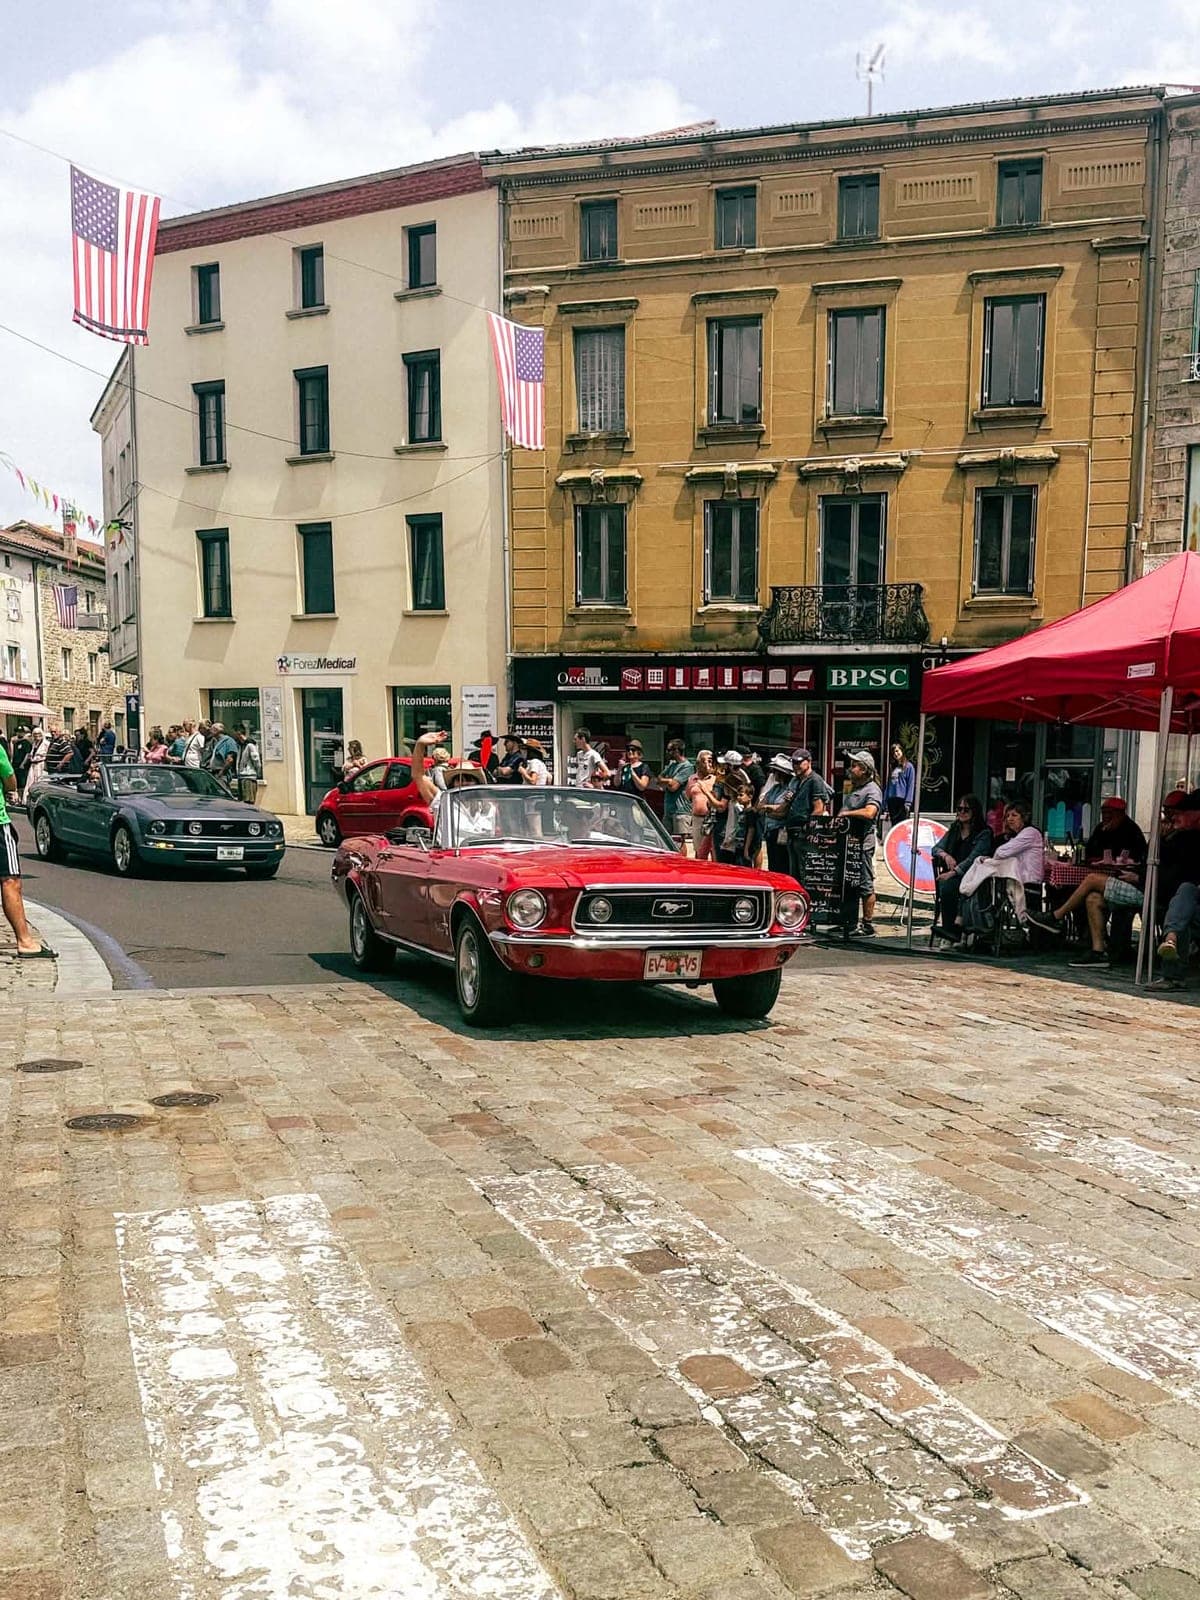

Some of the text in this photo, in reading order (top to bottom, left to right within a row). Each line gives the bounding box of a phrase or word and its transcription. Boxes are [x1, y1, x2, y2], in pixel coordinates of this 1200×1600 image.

[293, 657, 356, 670] ForezMedical
[557, 671, 609, 685] Océane
[830, 668, 907, 687] BPSC
